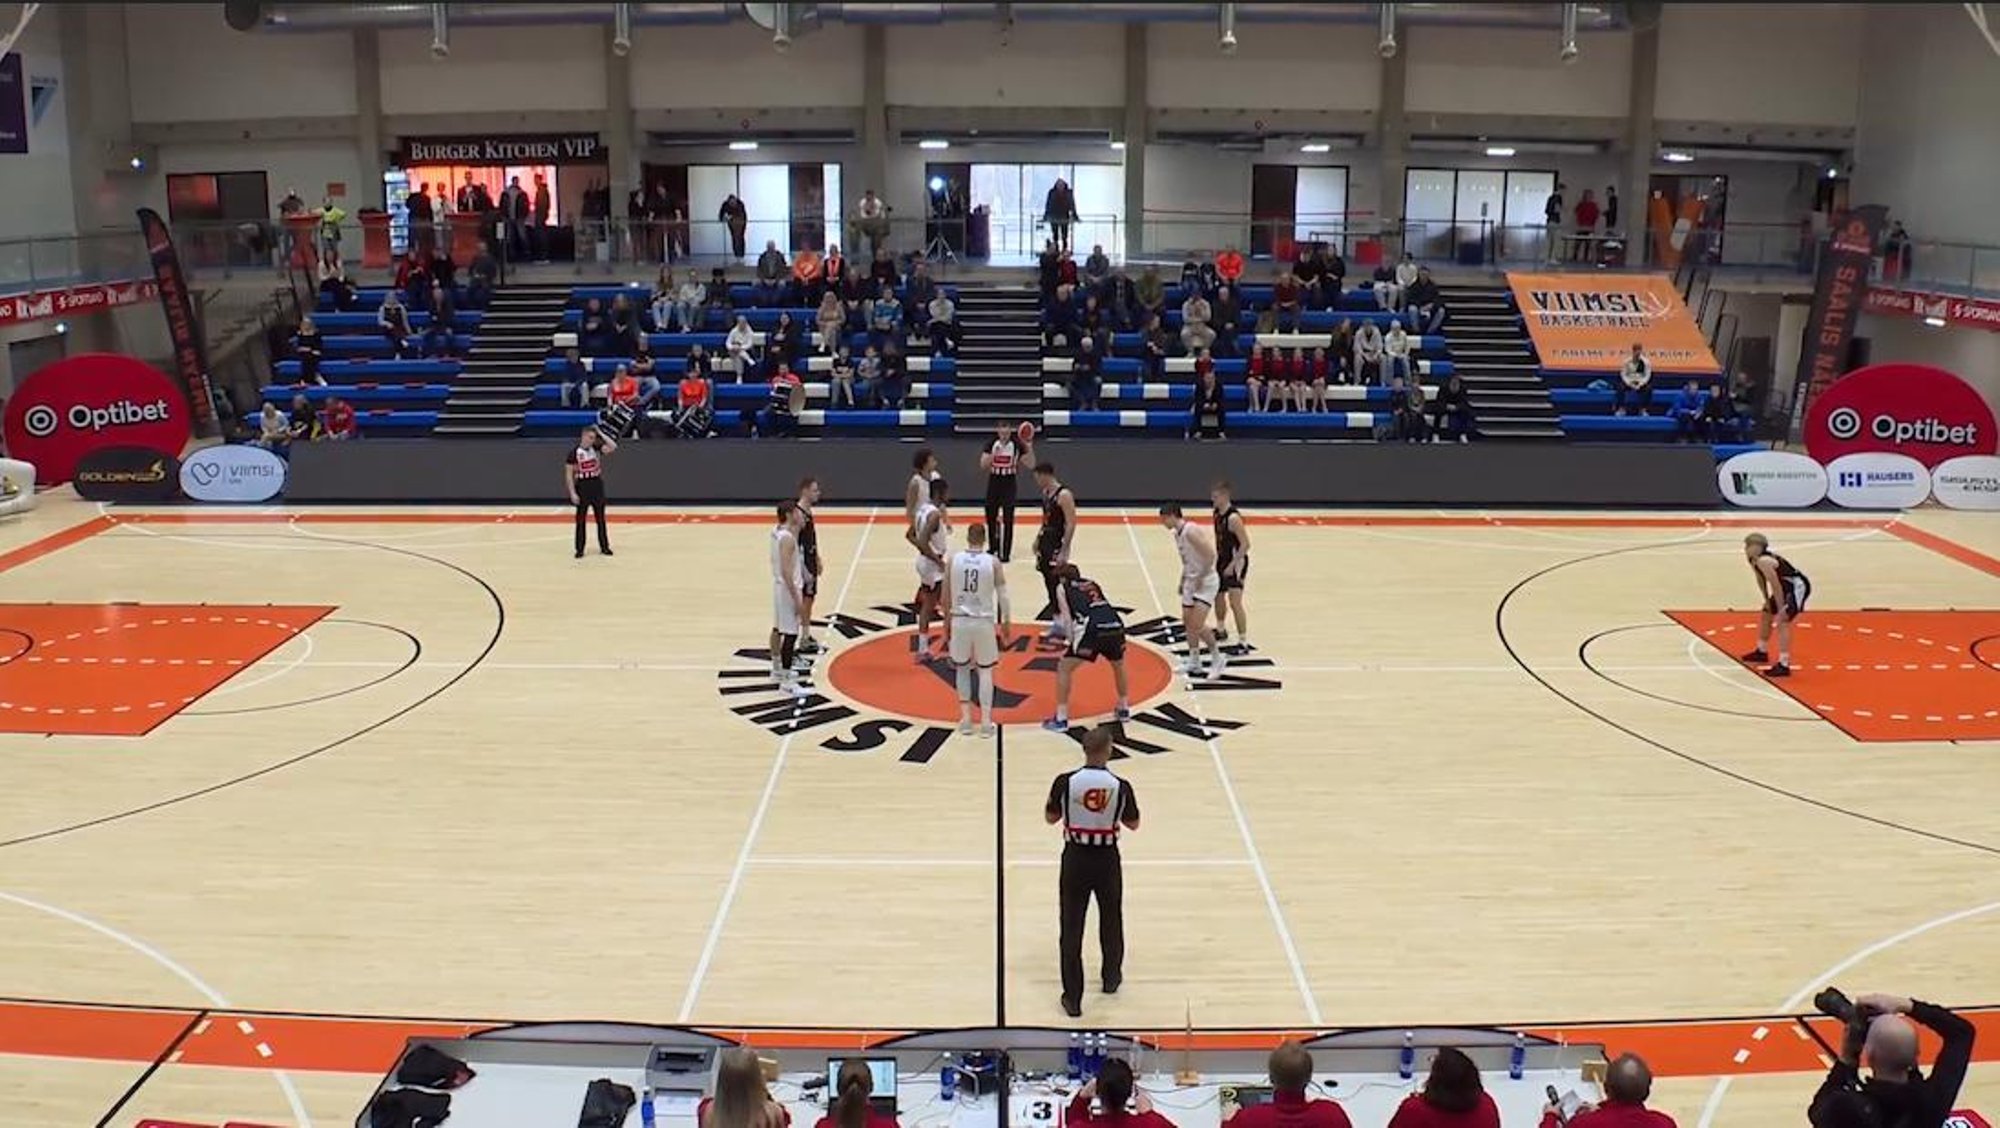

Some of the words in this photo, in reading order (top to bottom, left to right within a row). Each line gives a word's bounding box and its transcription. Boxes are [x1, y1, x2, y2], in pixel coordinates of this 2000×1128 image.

[563, 138, 596, 157] VIP
[1531, 291, 1643, 313] VIIMSI
[1820, 267, 1856, 346] SAALIS
[1540, 314, 1651, 328] BASKETBALL
[68, 399, 169, 430] Optibet
[1871, 413, 1978, 444] Optibet
[1866, 472, 1914, 483] HAUSERS
[962, 568, 979, 594] 13
[1032, 1101, 1052, 1120] 3
